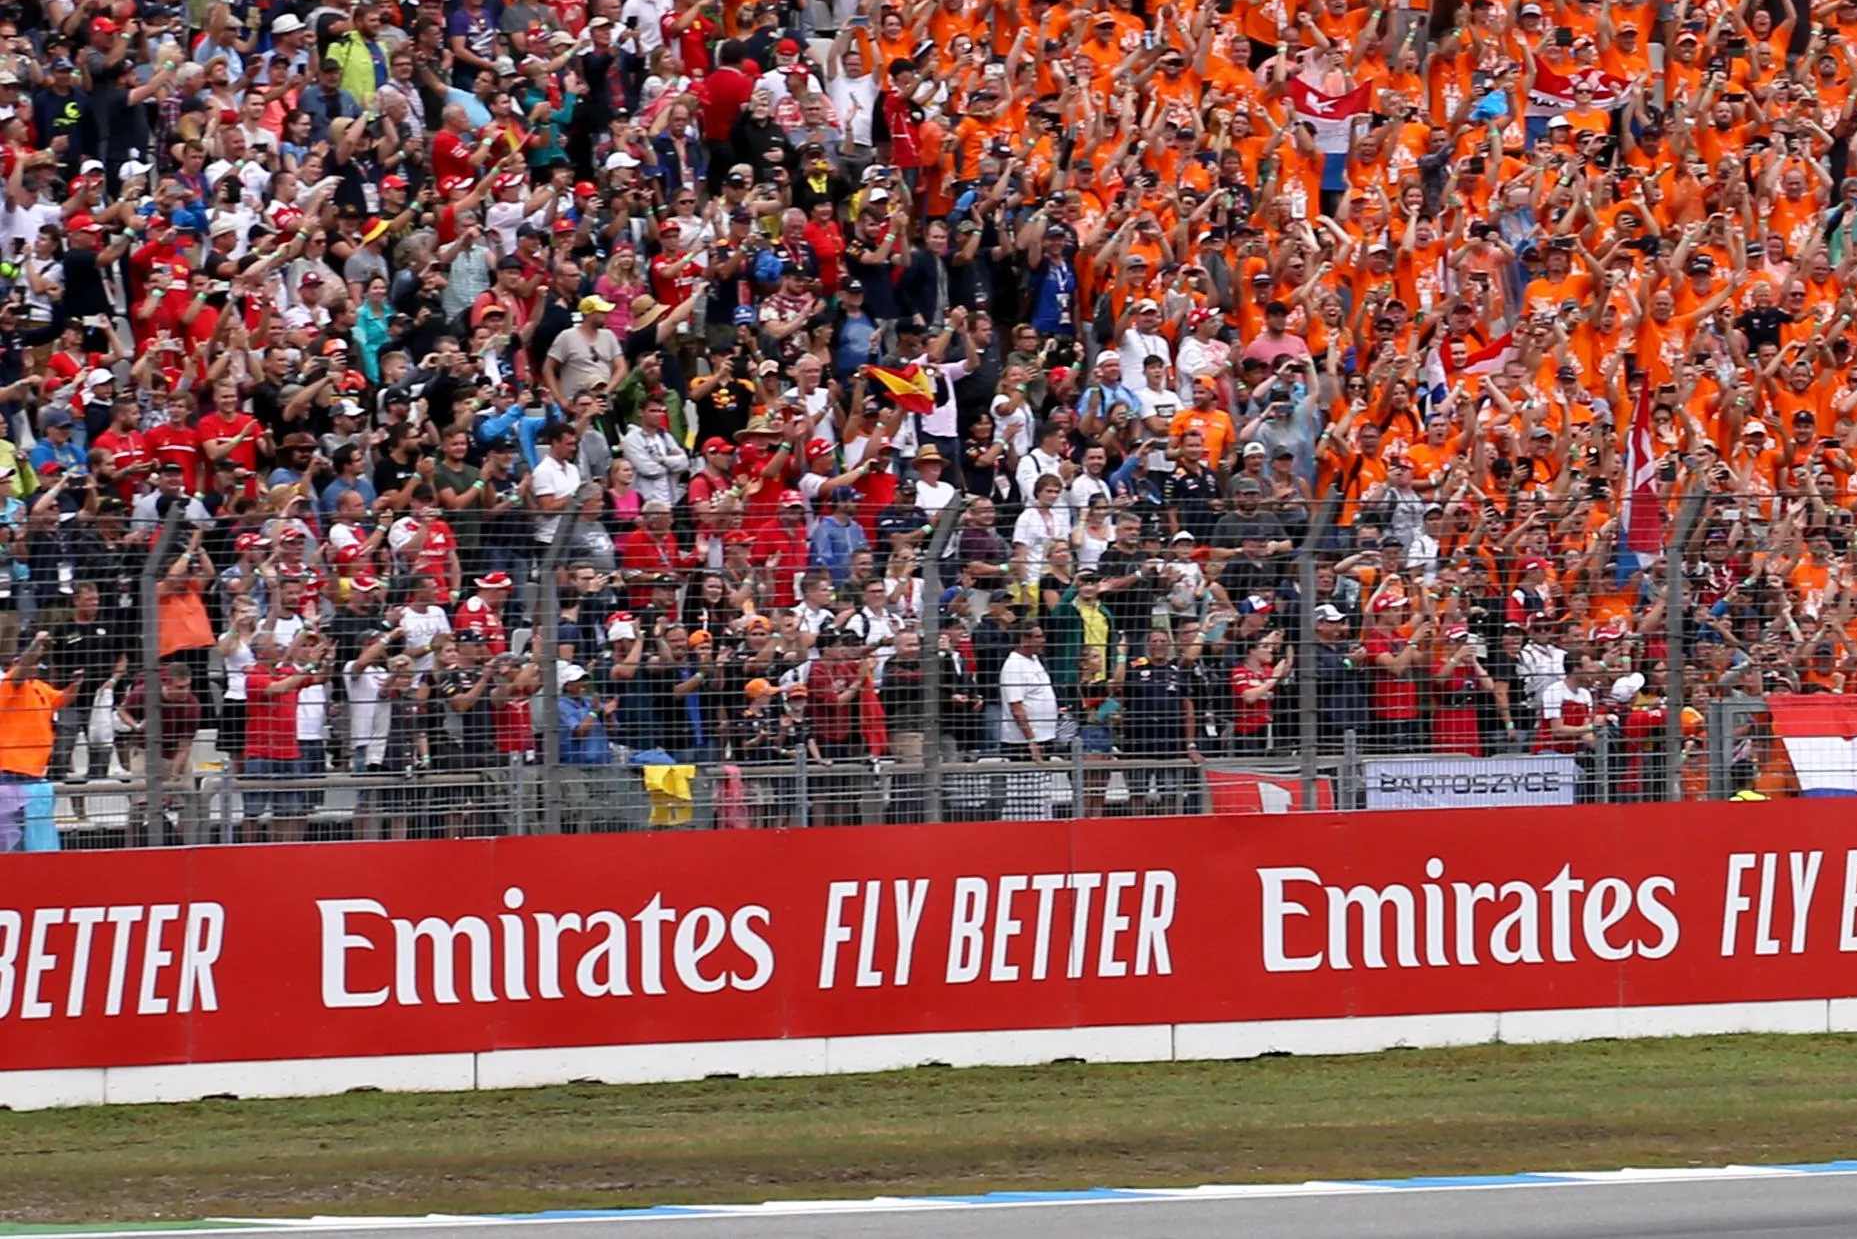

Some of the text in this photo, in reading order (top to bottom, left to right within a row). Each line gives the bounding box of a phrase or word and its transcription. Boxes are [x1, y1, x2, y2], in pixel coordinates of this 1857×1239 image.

[1380, 770, 1560, 795] BARTOSZYCE
[315, 869, 1177, 1009] Emirates FLY BETTER
[1256, 856, 1680, 972] Emirates
[1720, 850, 1823, 957] FLY
